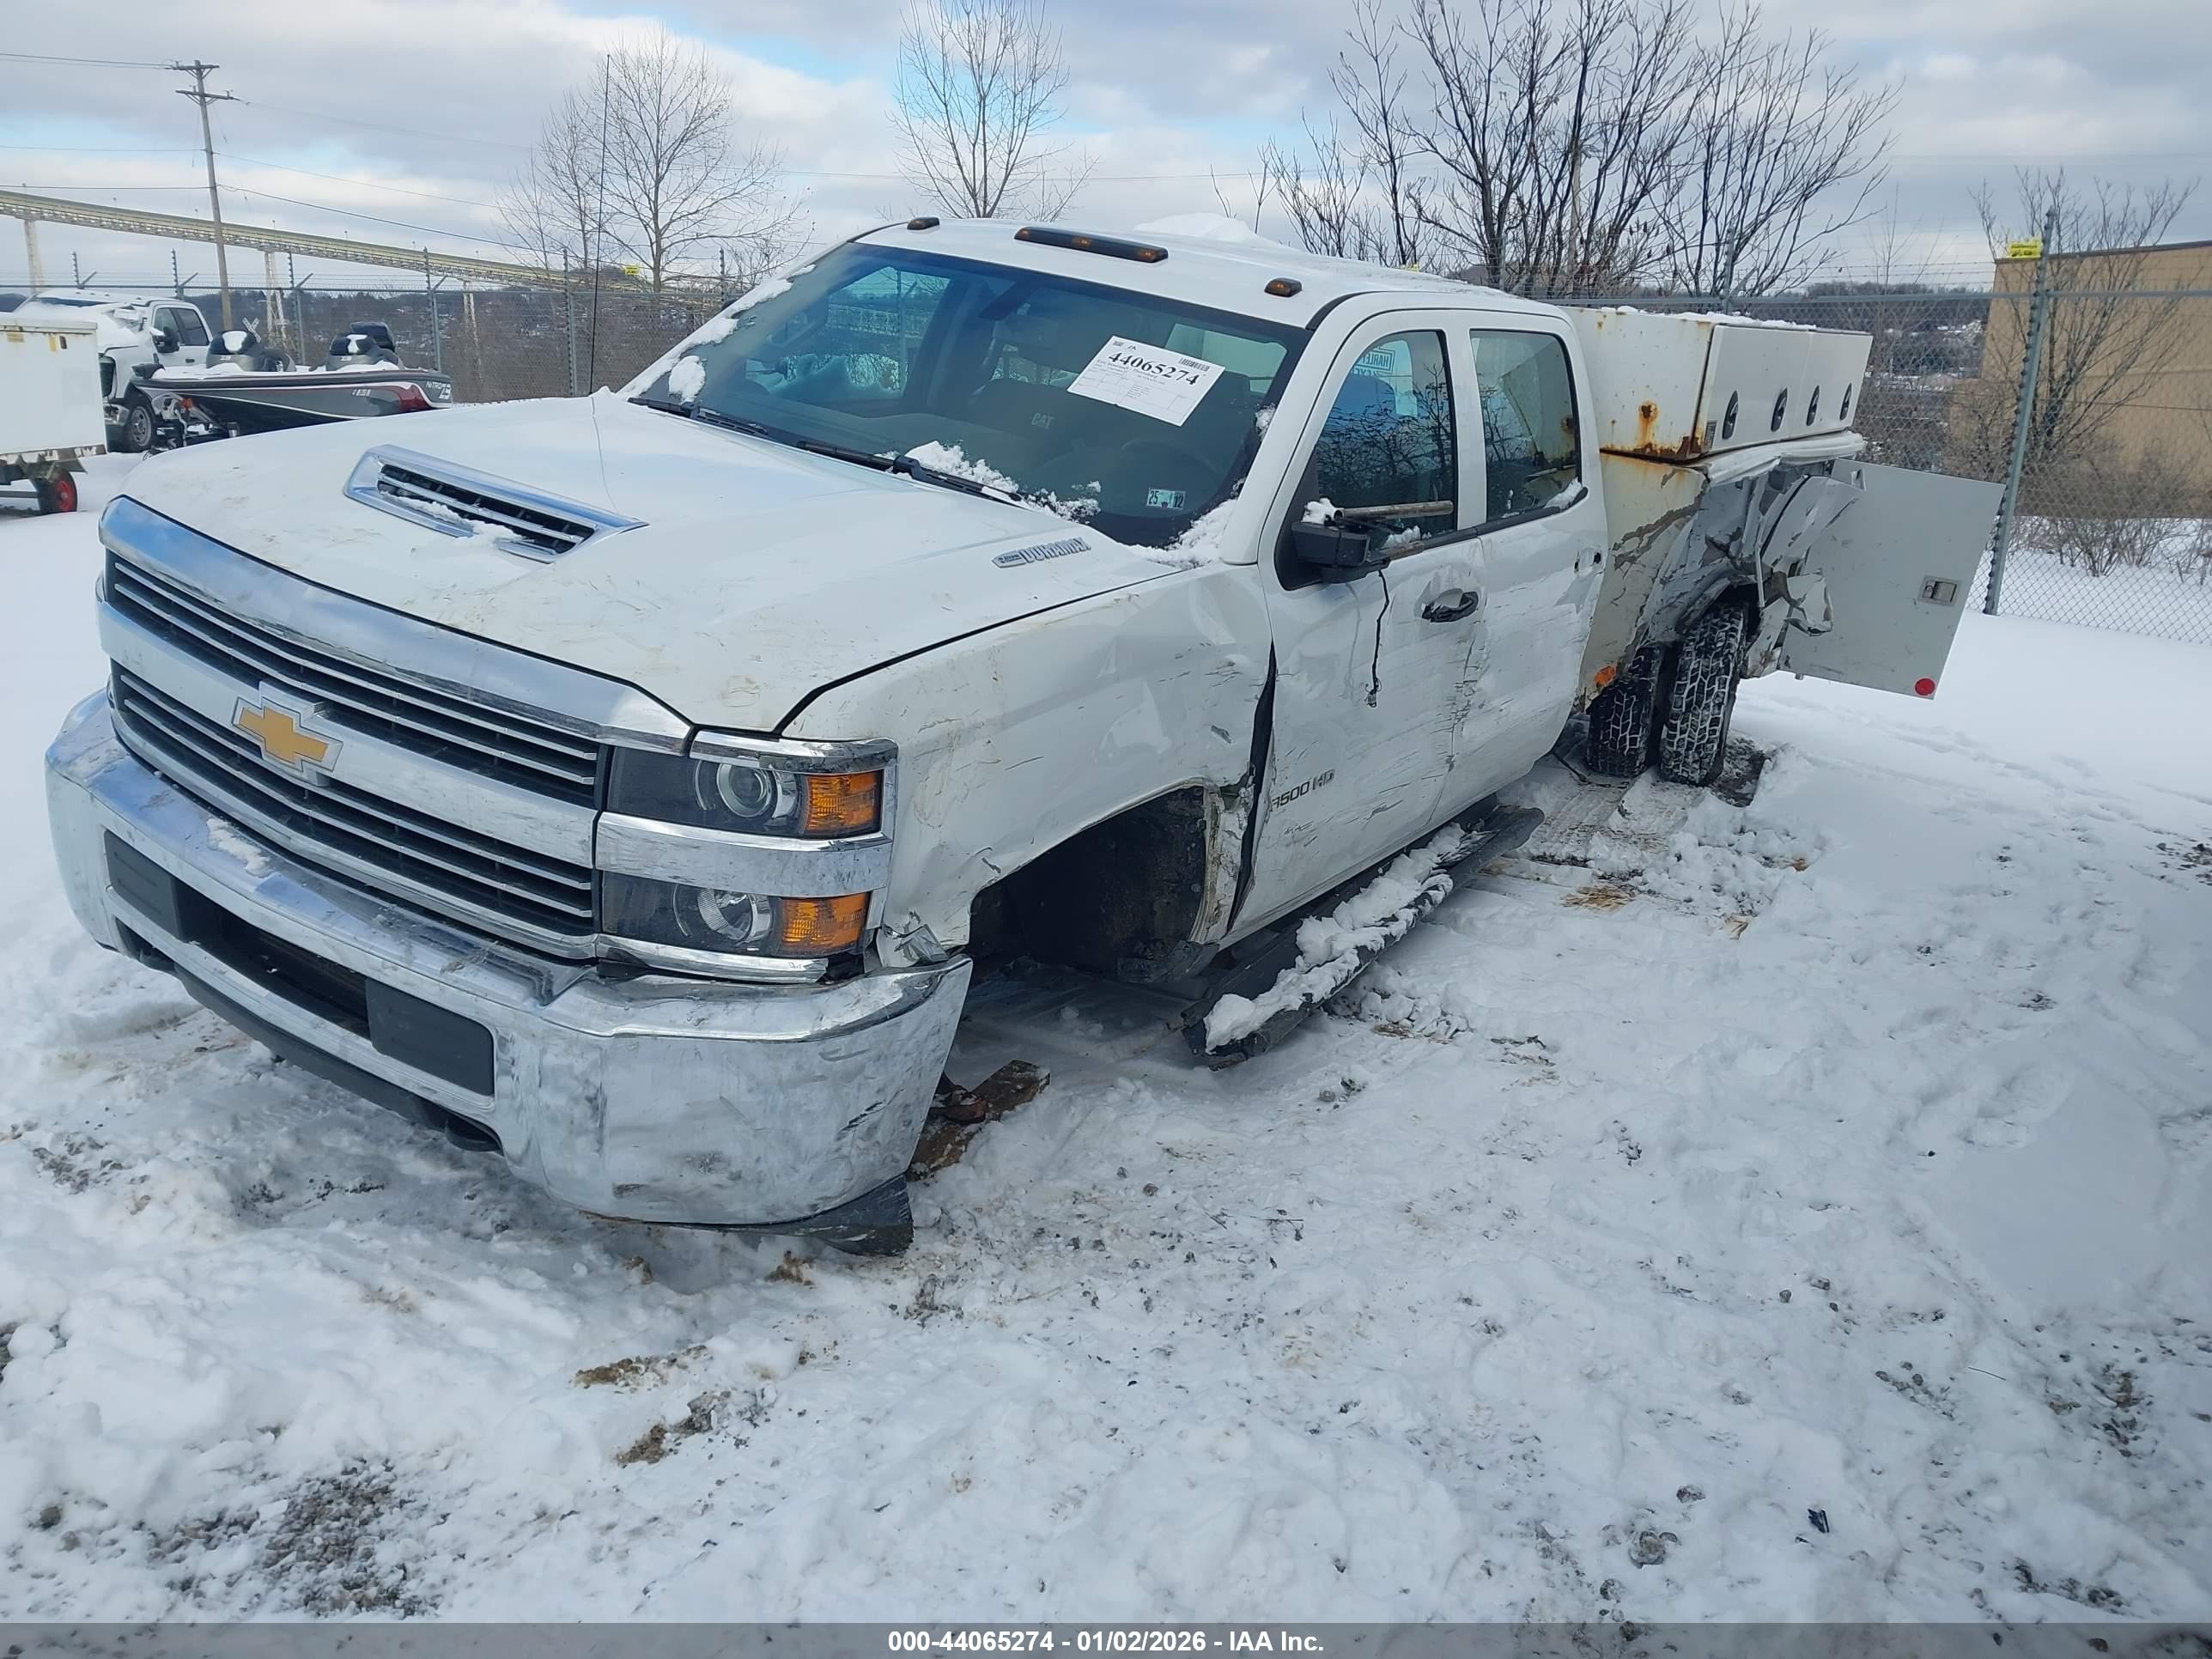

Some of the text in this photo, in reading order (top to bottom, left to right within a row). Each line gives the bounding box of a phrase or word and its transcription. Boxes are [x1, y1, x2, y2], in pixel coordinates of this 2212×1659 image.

[1109, 353, 1200, 385] 44065274
[1031, 412, 1055, 428] CAT
[1149, 490, 1184, 508] 25 12
[1018, 537, 1091, 563] DURAMAX
